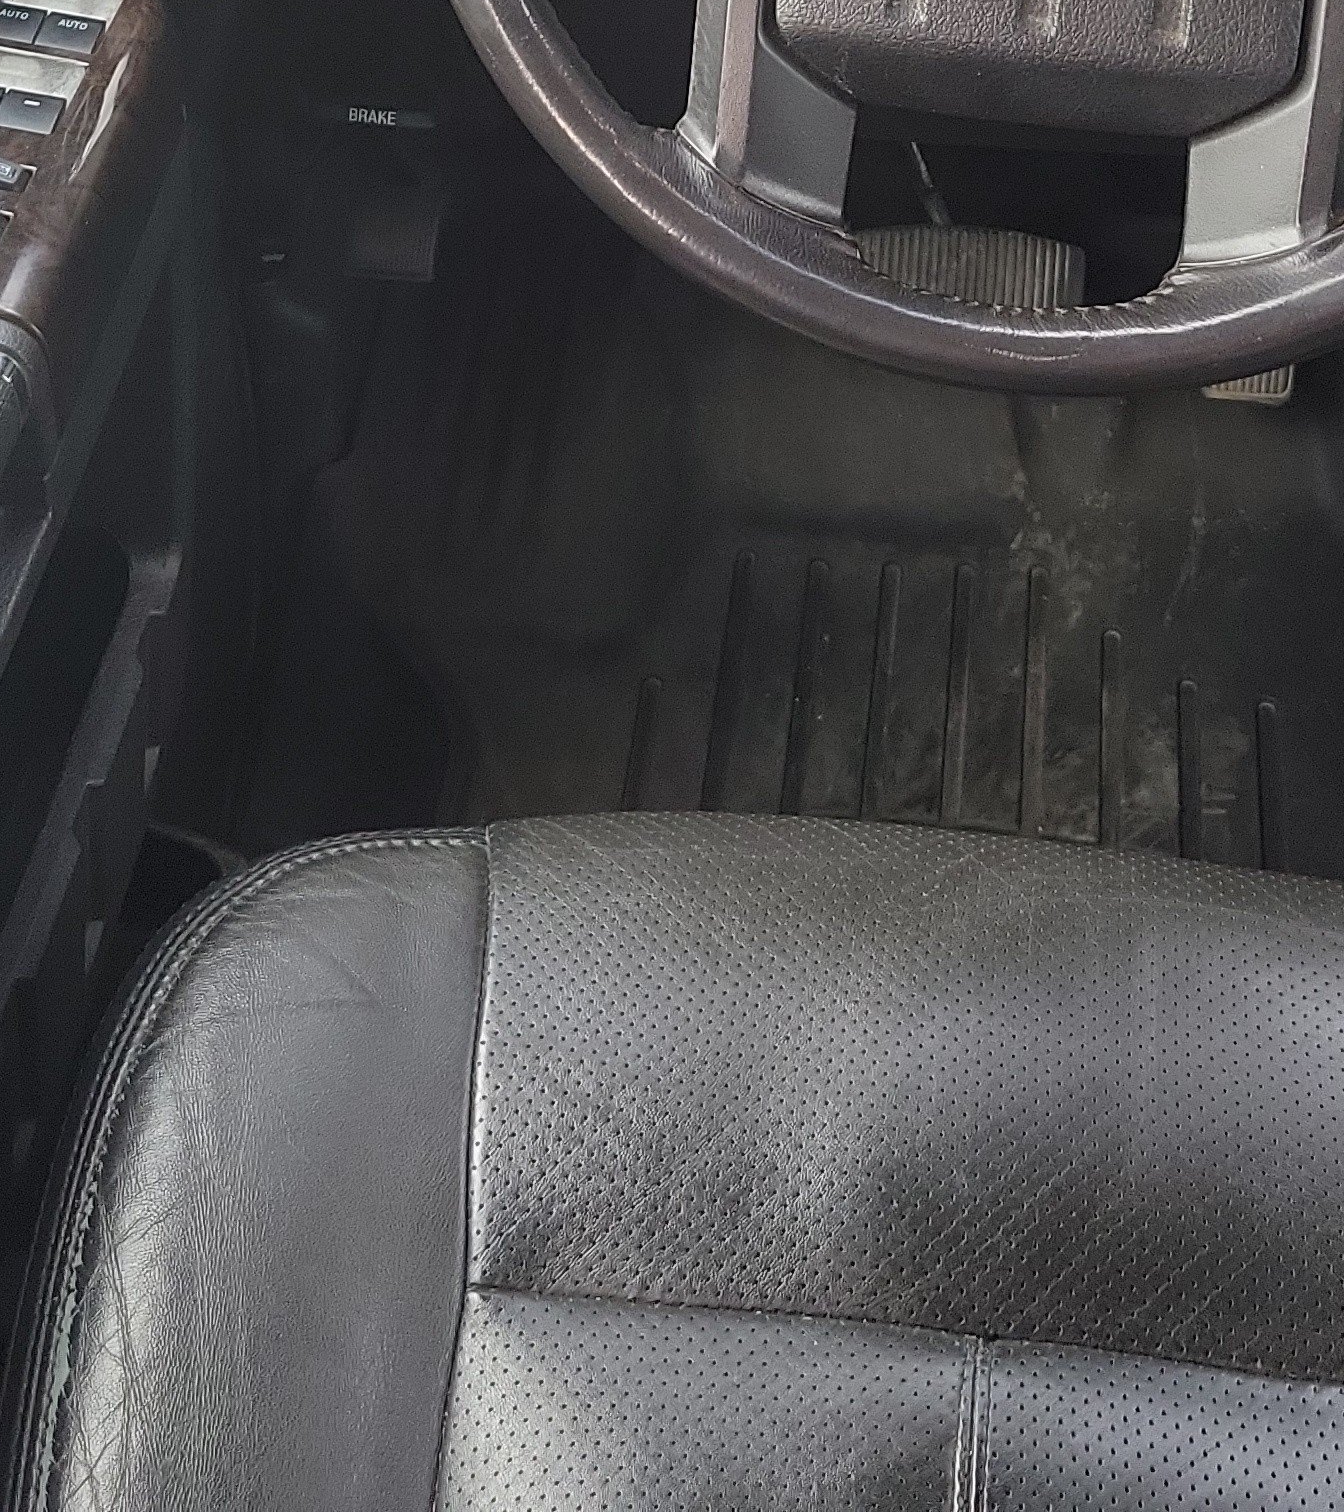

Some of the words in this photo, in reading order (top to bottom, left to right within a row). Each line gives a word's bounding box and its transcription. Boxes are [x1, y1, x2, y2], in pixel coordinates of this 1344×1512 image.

[0, 8, 29, 20] AUTO
[58, 18, 88, 30] AUTO
[349, 108, 397, 125] BRAKE
